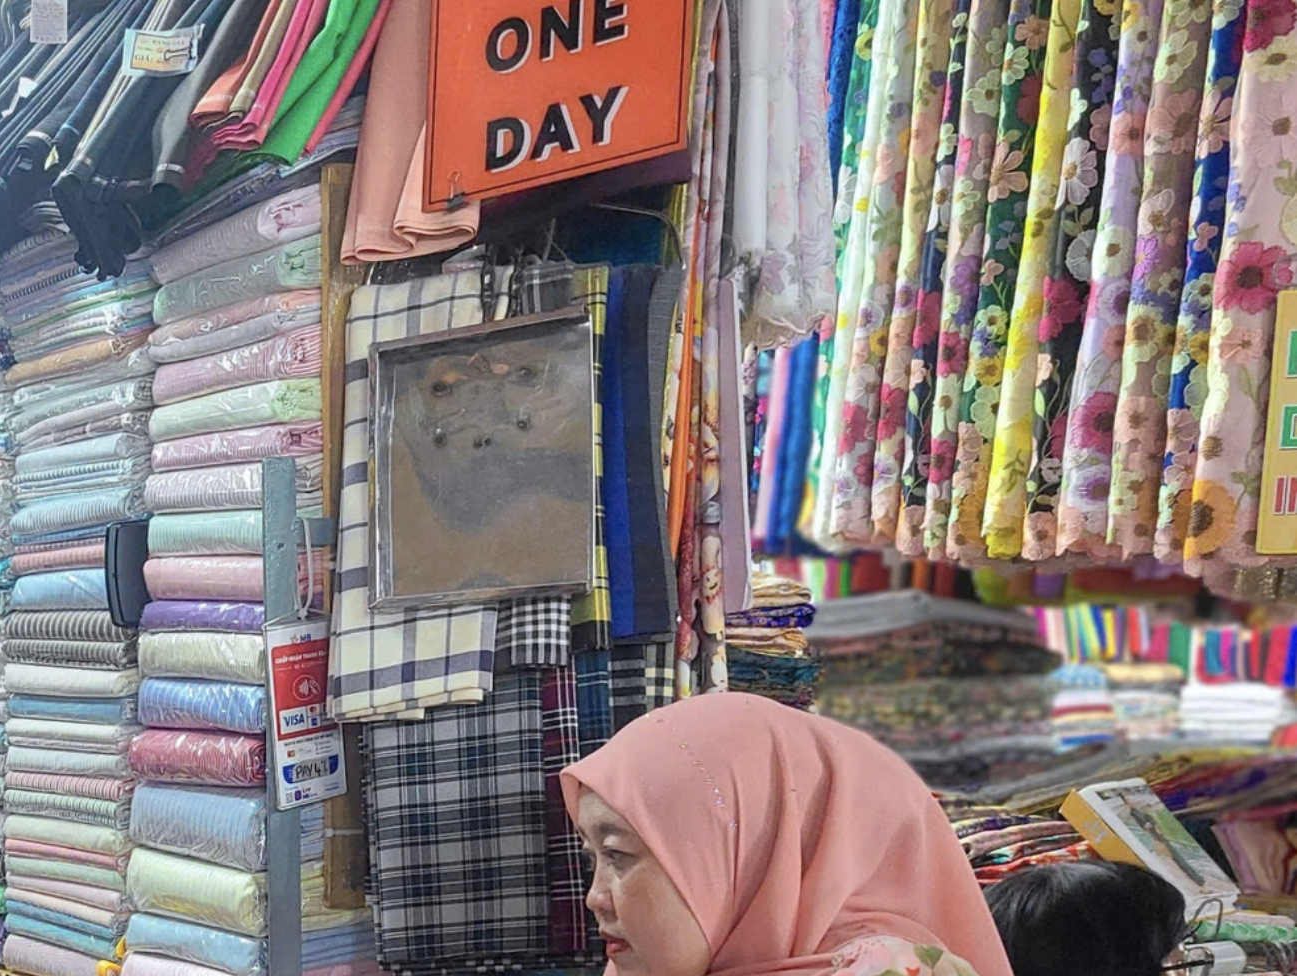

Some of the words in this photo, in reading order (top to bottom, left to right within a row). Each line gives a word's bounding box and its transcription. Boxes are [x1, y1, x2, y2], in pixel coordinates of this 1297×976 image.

[485, 0, 629, 75] ONE
[485, 85, 630, 173] DAY
[283, 713, 305, 728] VISA
